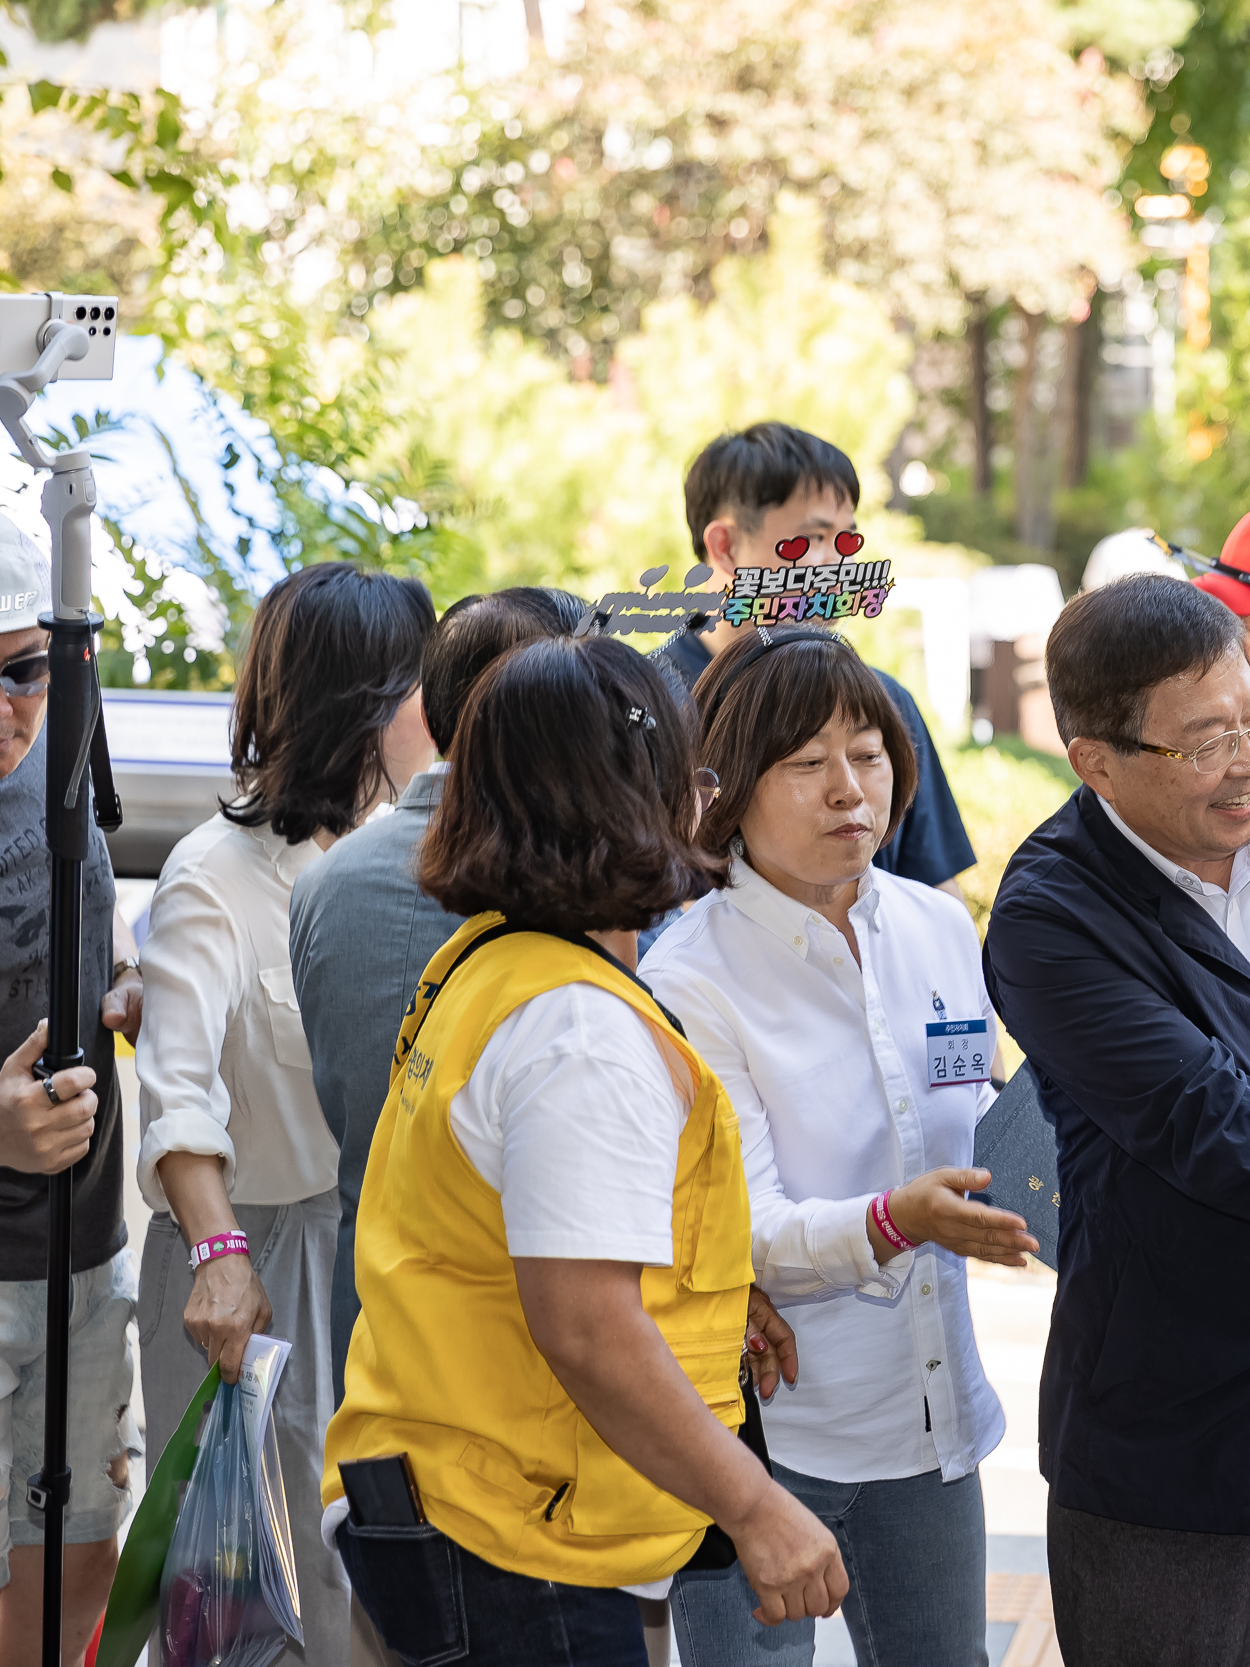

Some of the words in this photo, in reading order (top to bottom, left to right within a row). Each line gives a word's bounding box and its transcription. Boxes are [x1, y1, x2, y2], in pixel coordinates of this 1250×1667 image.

[734, 560, 891, 598] 꽃보다주민!!!
[724, 587, 889, 627] 주민자치회장
[934, 1053, 985, 1078] 김순옥
